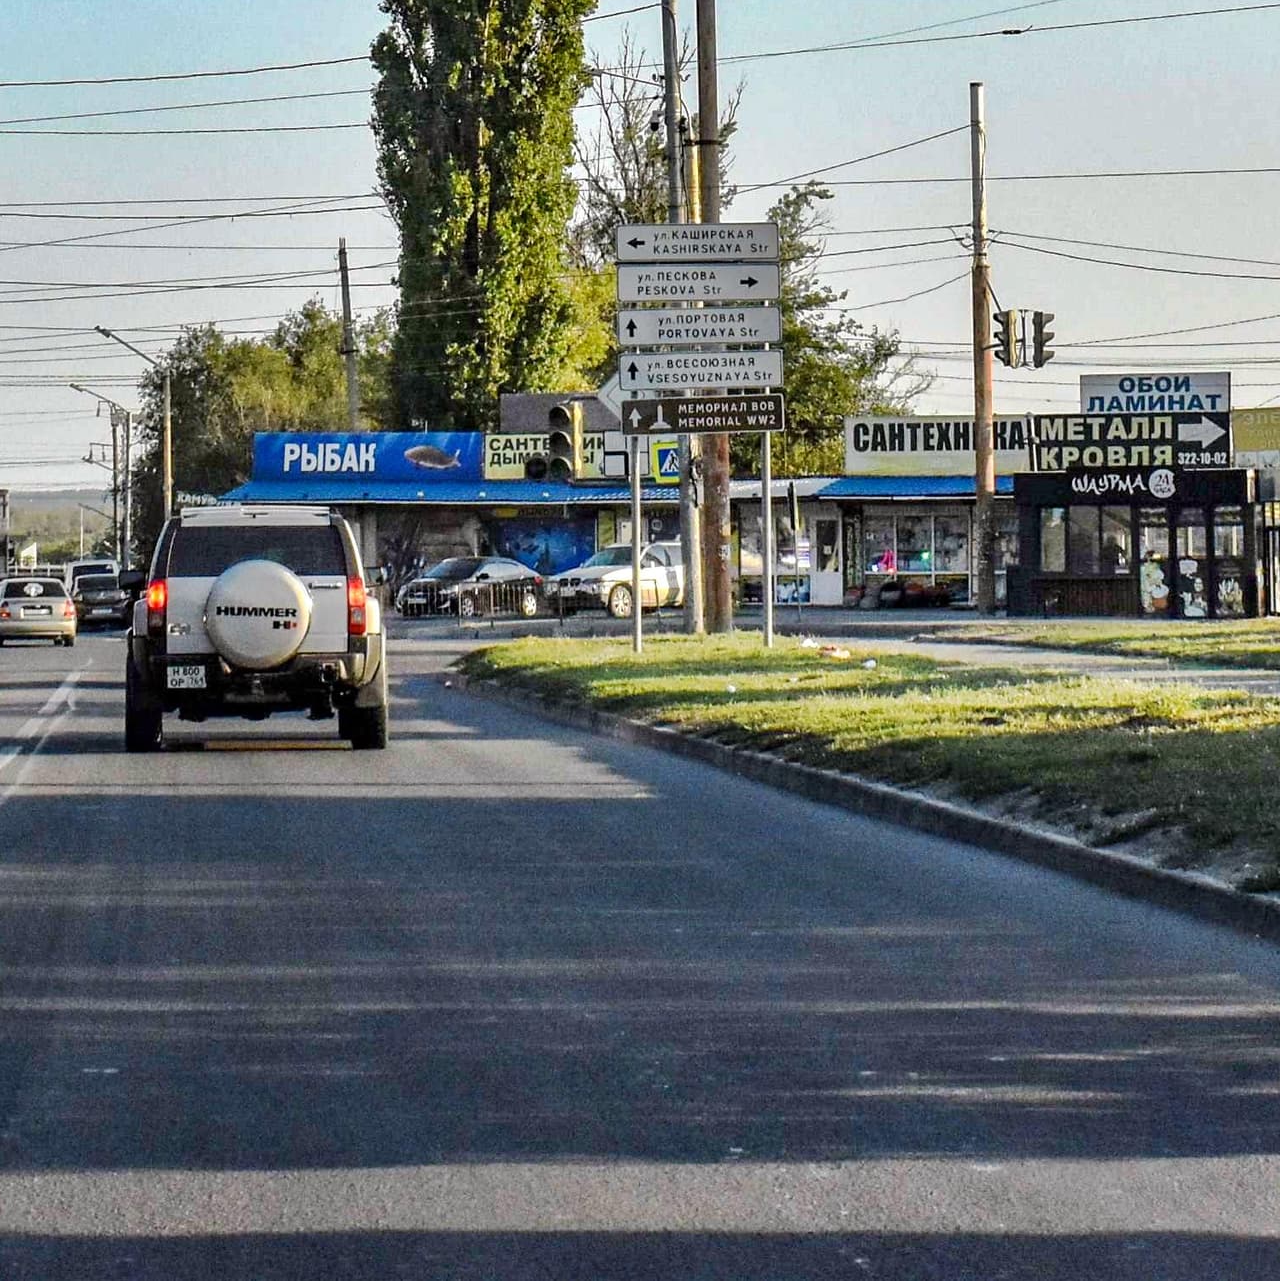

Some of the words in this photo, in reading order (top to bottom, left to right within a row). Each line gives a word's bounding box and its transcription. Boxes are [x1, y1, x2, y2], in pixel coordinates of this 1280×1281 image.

[653, 244, 742, 255] KASHIRSKAYA
[750, 243, 768, 253] Str
[638, 285, 695, 296] PESKOVA
[704, 285, 722, 295] Str
[658, 328, 735, 339] PORTOVAYA
[740, 327, 759, 337] Str
[648, 371, 750, 384] VSESOYUZNAYA
[754, 371, 773, 381] Str
[1118, 376, 1190, 393] ОБОИ
[678, 402, 747, 414] МЕМОРИАЛ
[752, 401, 775, 411] ВОВ
[1087, 394, 1222, 412] ЛАМИНАТ
[678, 416, 740, 428] MEMORIAL
[747, 415, 776, 426] WW2
[1040, 416, 1173, 441] МЕТАЛЛ
[853, 421, 1024, 452] САНТЕХНКА
[283, 443, 376, 472] РЫБАК
[1040, 445, 1173, 469] КРОВЛЯ
[1178, 452, 1227, 465] 322-10-02
[1072, 473, 1148, 495] ШАУРМА
[216, 606, 297, 617] HUMMER
